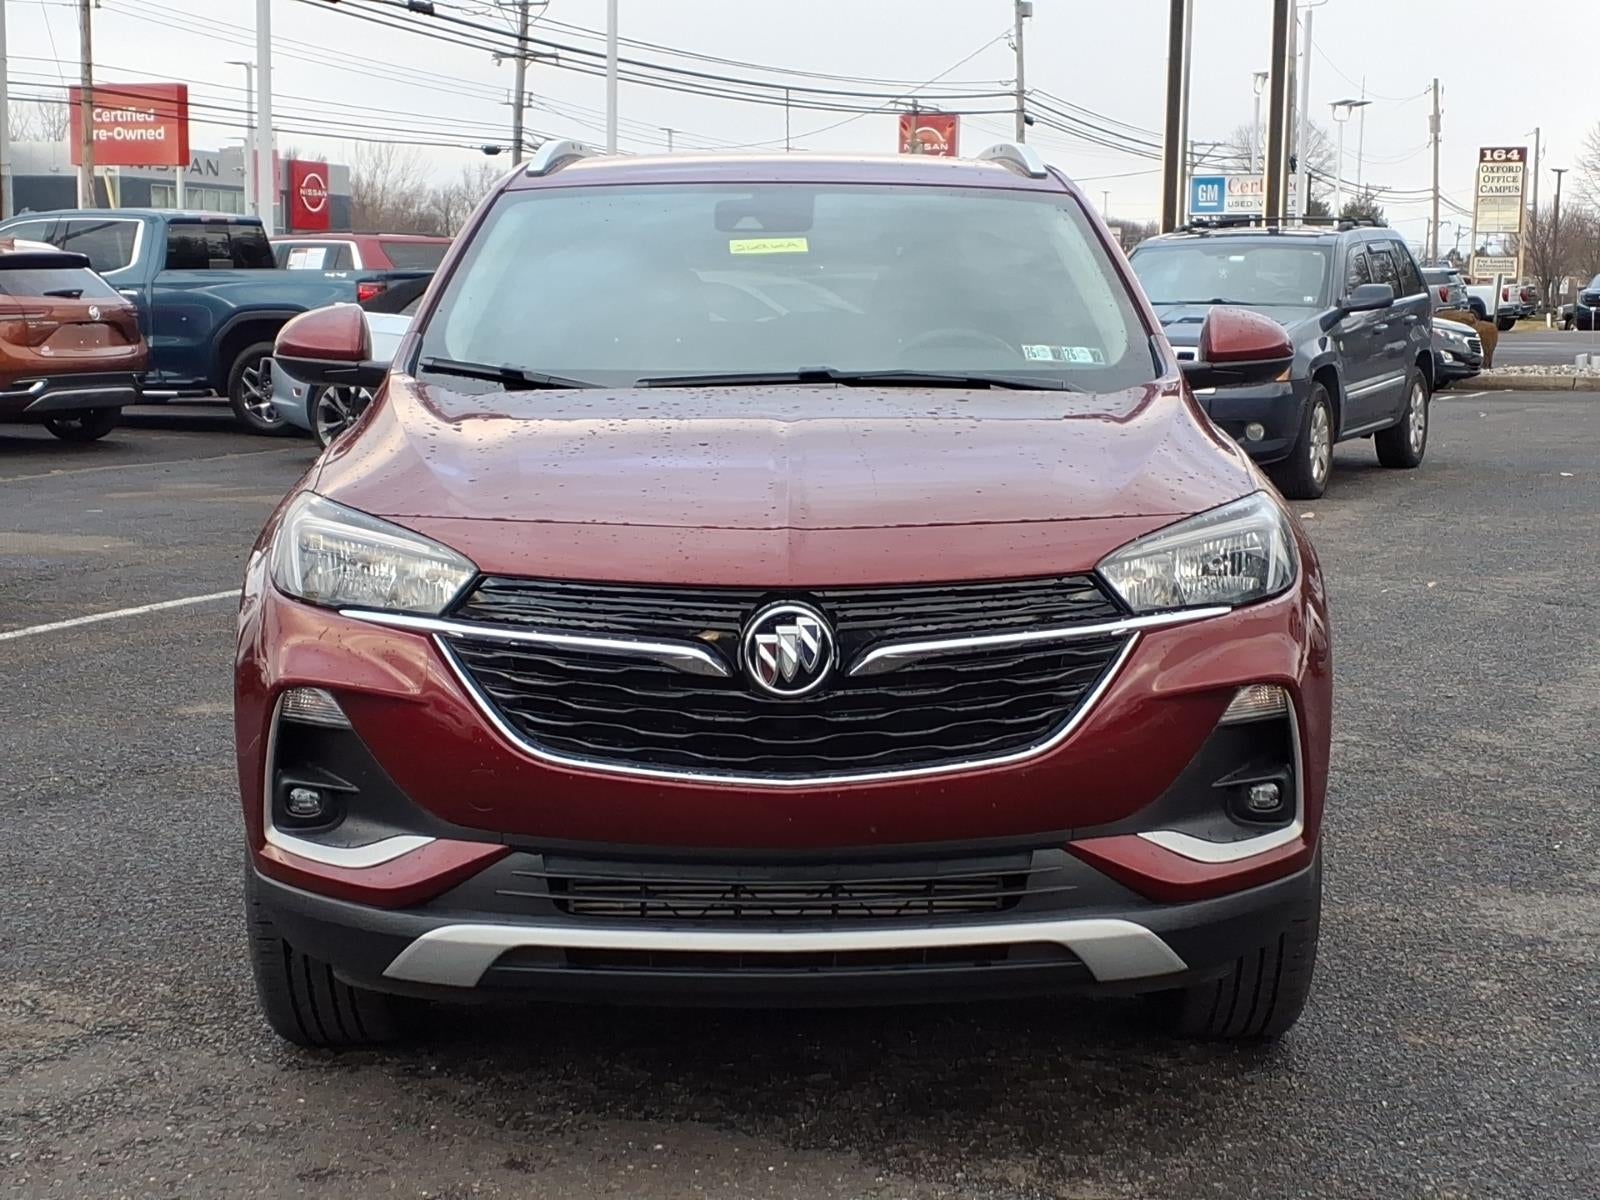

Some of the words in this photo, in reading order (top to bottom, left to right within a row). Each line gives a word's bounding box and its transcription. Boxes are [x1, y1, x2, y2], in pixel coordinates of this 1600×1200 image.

[93, 107, 155, 122] Certified
[92, 126, 165, 140] re-Owned
[903, 143, 949, 151] NSAN
[1482, 149, 1520, 161] 164
[1480, 165, 1522, 173] OXFORD
[1483, 175, 1519, 183] OFFICE
[300, 188, 328, 197] NISSAN
[1198, 184, 1218, 201] GM
[1480, 185, 1520, 193] CAMPUS
[1227, 200, 1253, 208] USED
